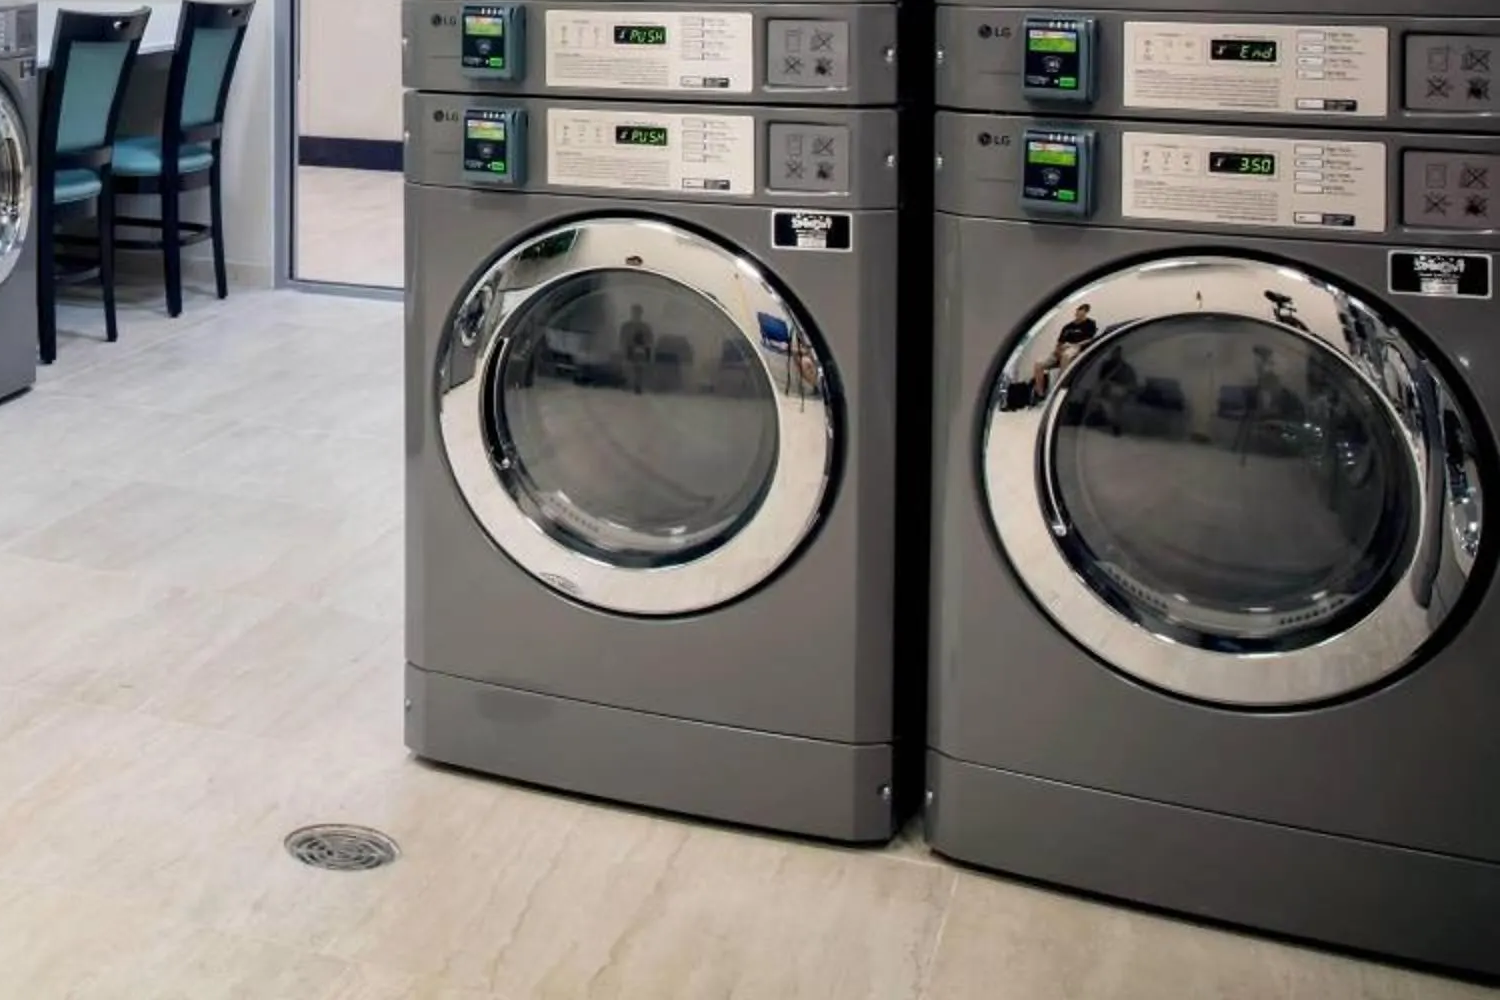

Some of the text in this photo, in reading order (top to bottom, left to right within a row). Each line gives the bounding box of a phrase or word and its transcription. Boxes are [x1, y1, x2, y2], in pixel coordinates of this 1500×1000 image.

[629, 29, 663, 43] PUSH
[1239, 44, 1273, 59] End
[631, 129, 665, 144] PUSH
